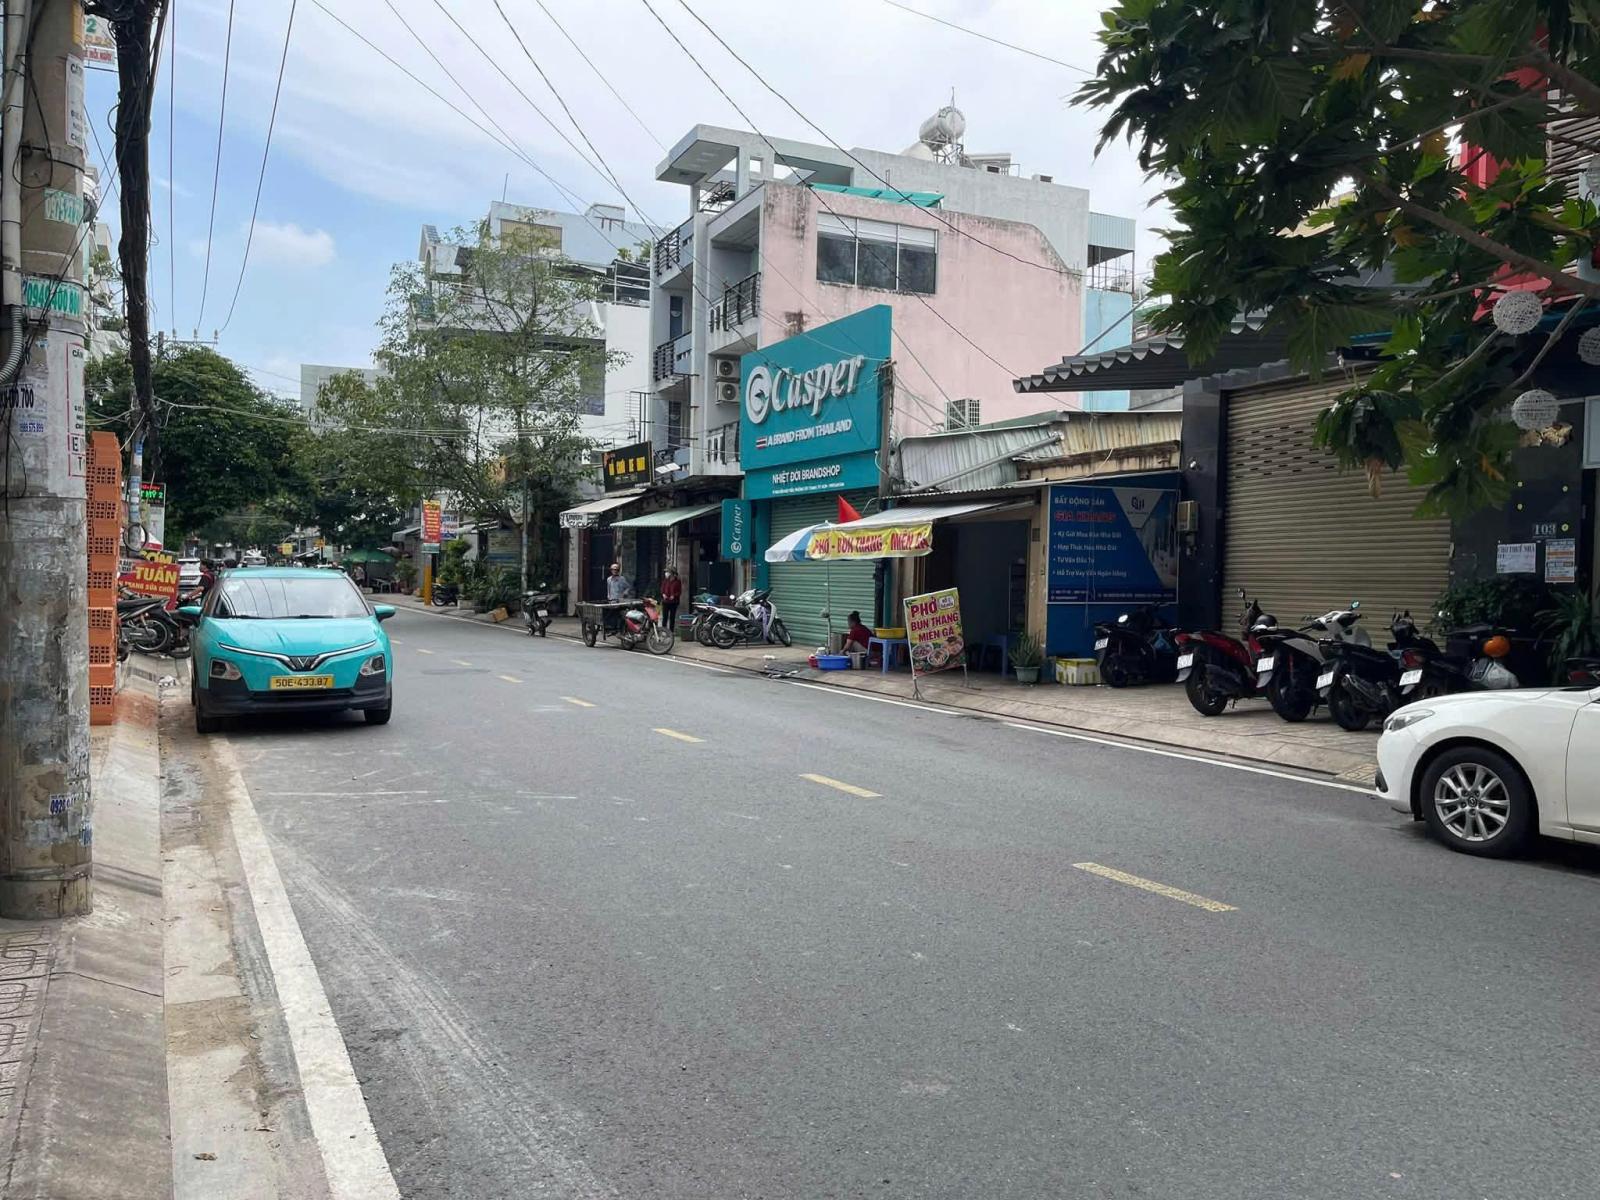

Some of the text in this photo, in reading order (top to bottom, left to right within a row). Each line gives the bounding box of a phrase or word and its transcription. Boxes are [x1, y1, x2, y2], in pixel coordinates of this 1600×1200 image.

[771, 355, 865, 416] Casper
[773, 431, 795, 445] BRAND
[795, 427, 815, 441] FROM
[815, 419, 852, 437] THAILAND
[802, 464, 840, 480] BRANDSHOP
[732, 504, 743, 540] Casper
[1535, 524, 1556, 535] 103
[910, 596, 938, 618] PHỞ
[930, 612, 959, 627] THANG
